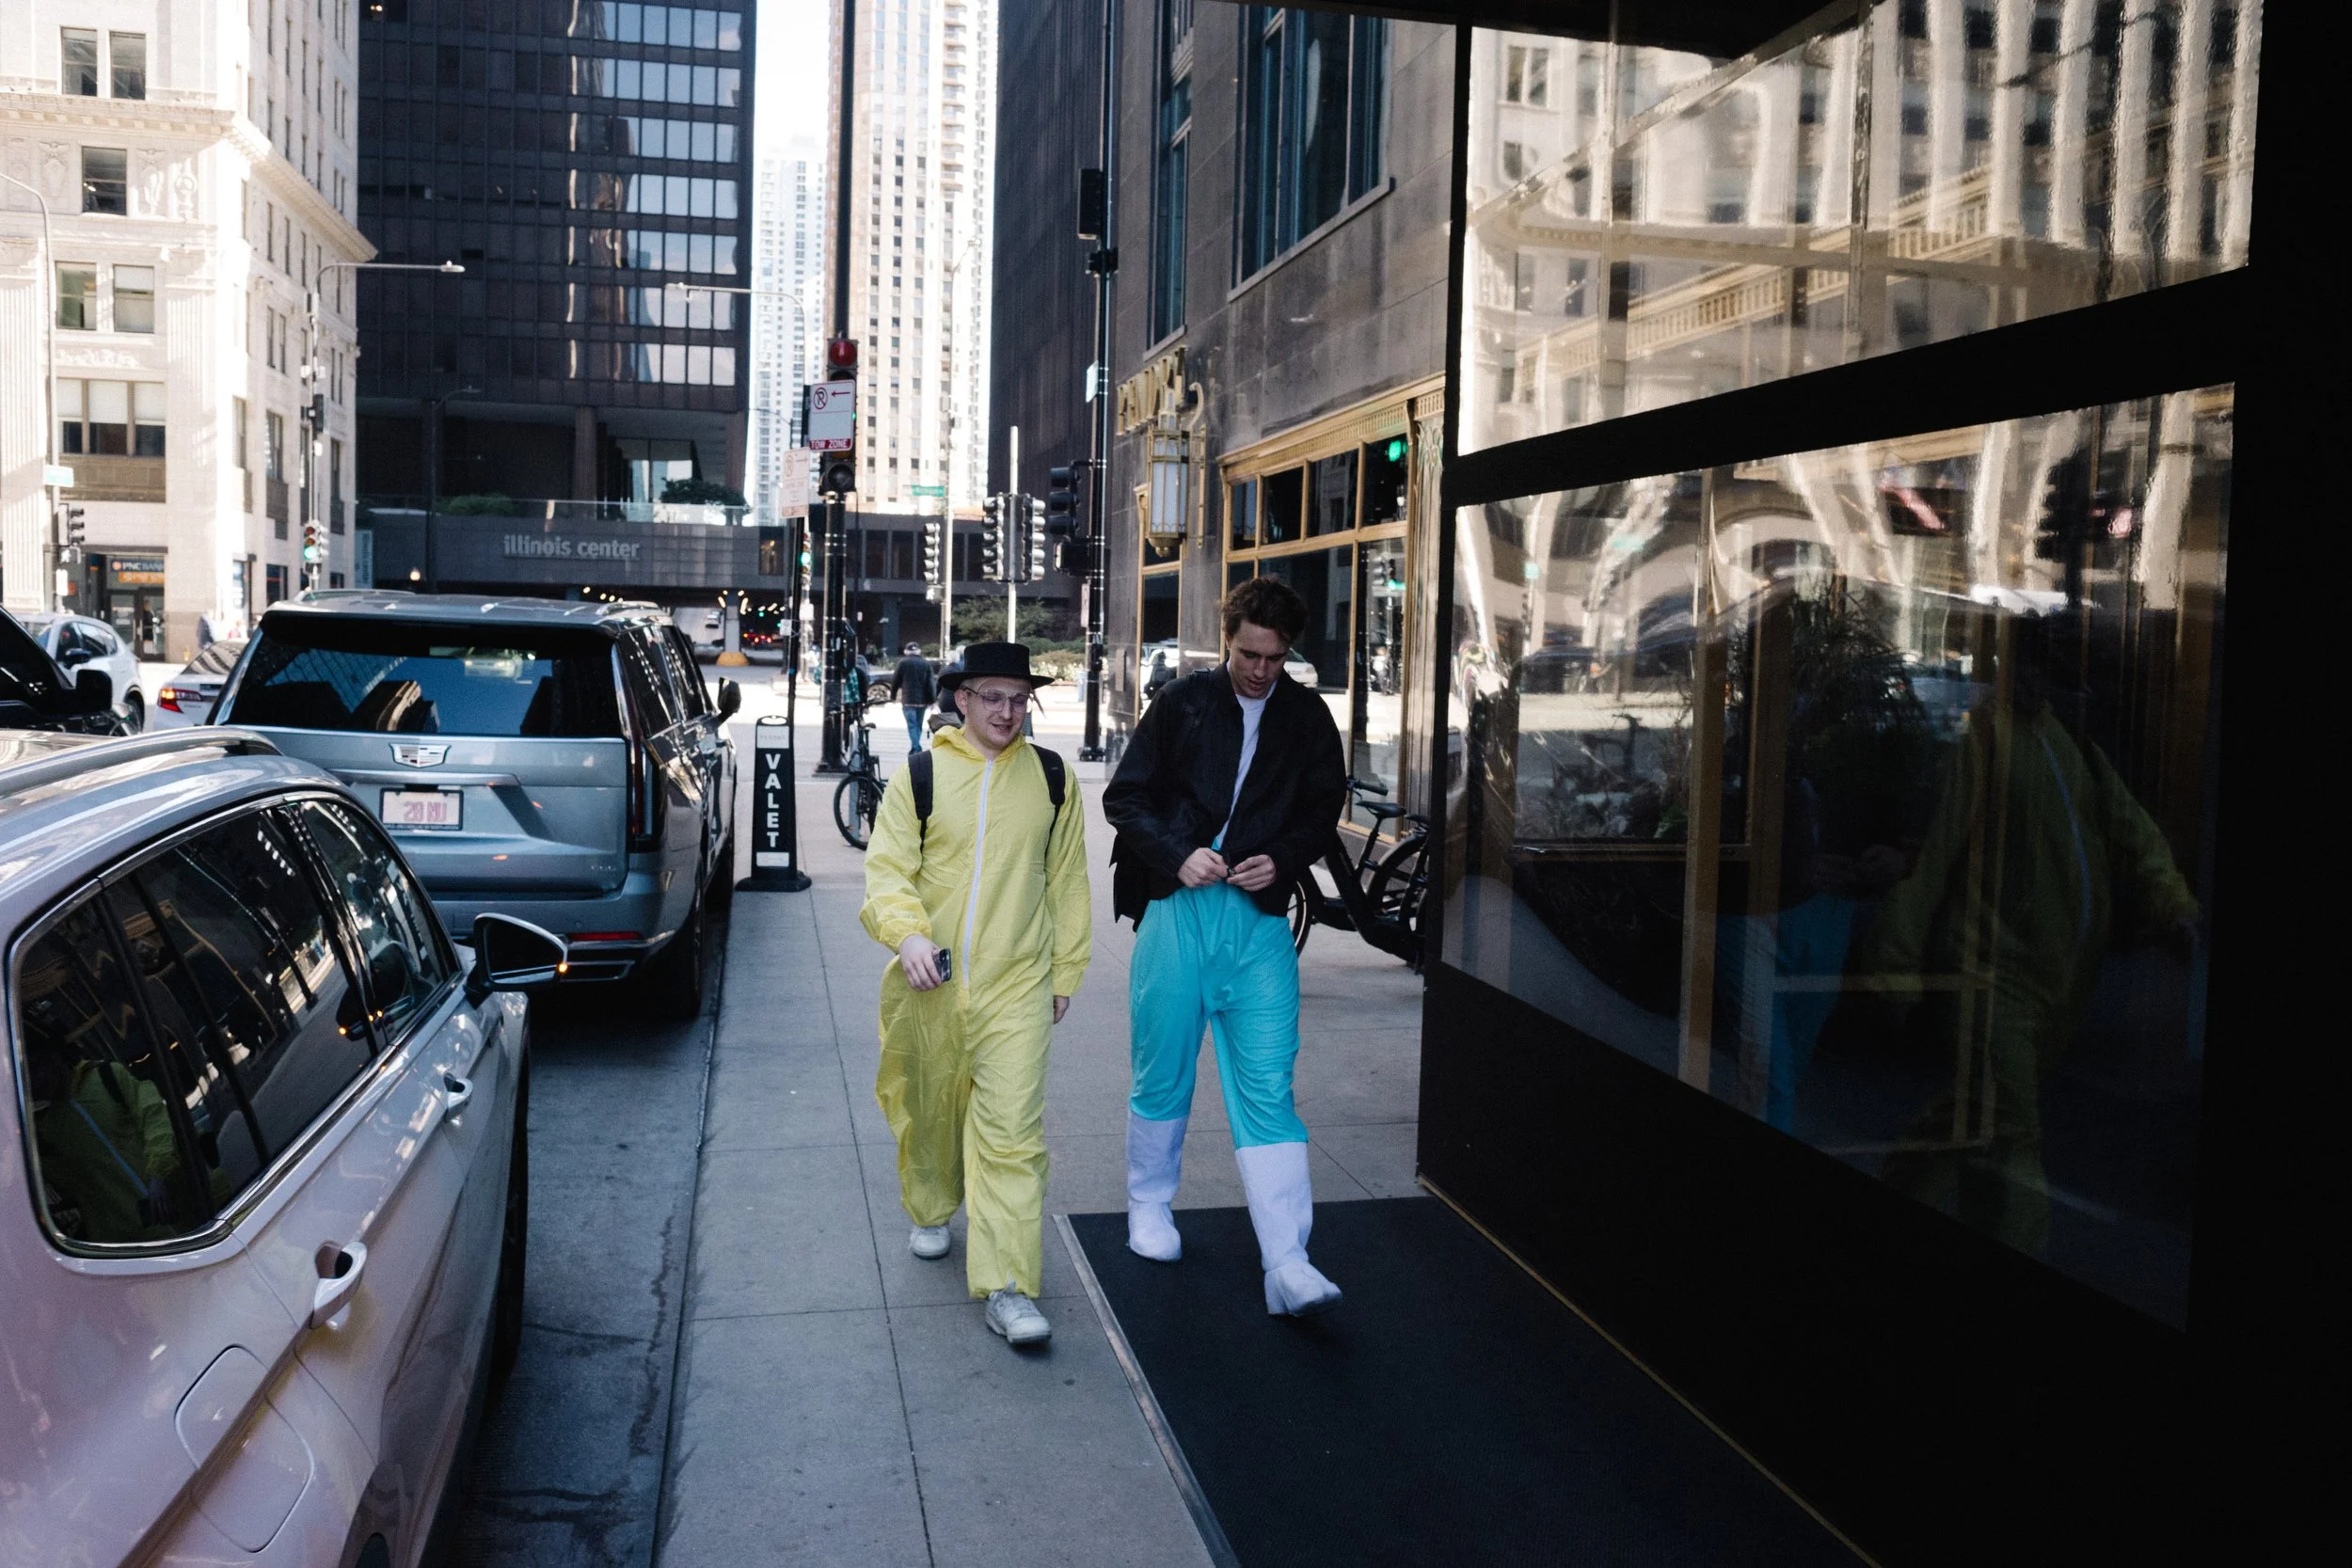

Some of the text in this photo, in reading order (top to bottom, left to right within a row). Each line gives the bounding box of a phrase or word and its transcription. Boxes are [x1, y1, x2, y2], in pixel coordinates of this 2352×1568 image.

[811, 439, 848, 450] TOW ZONE
[503, 534, 641, 557] illinois center
[122, 562, 141, 570] PNC
[764, 753, 782, 847] VALET
